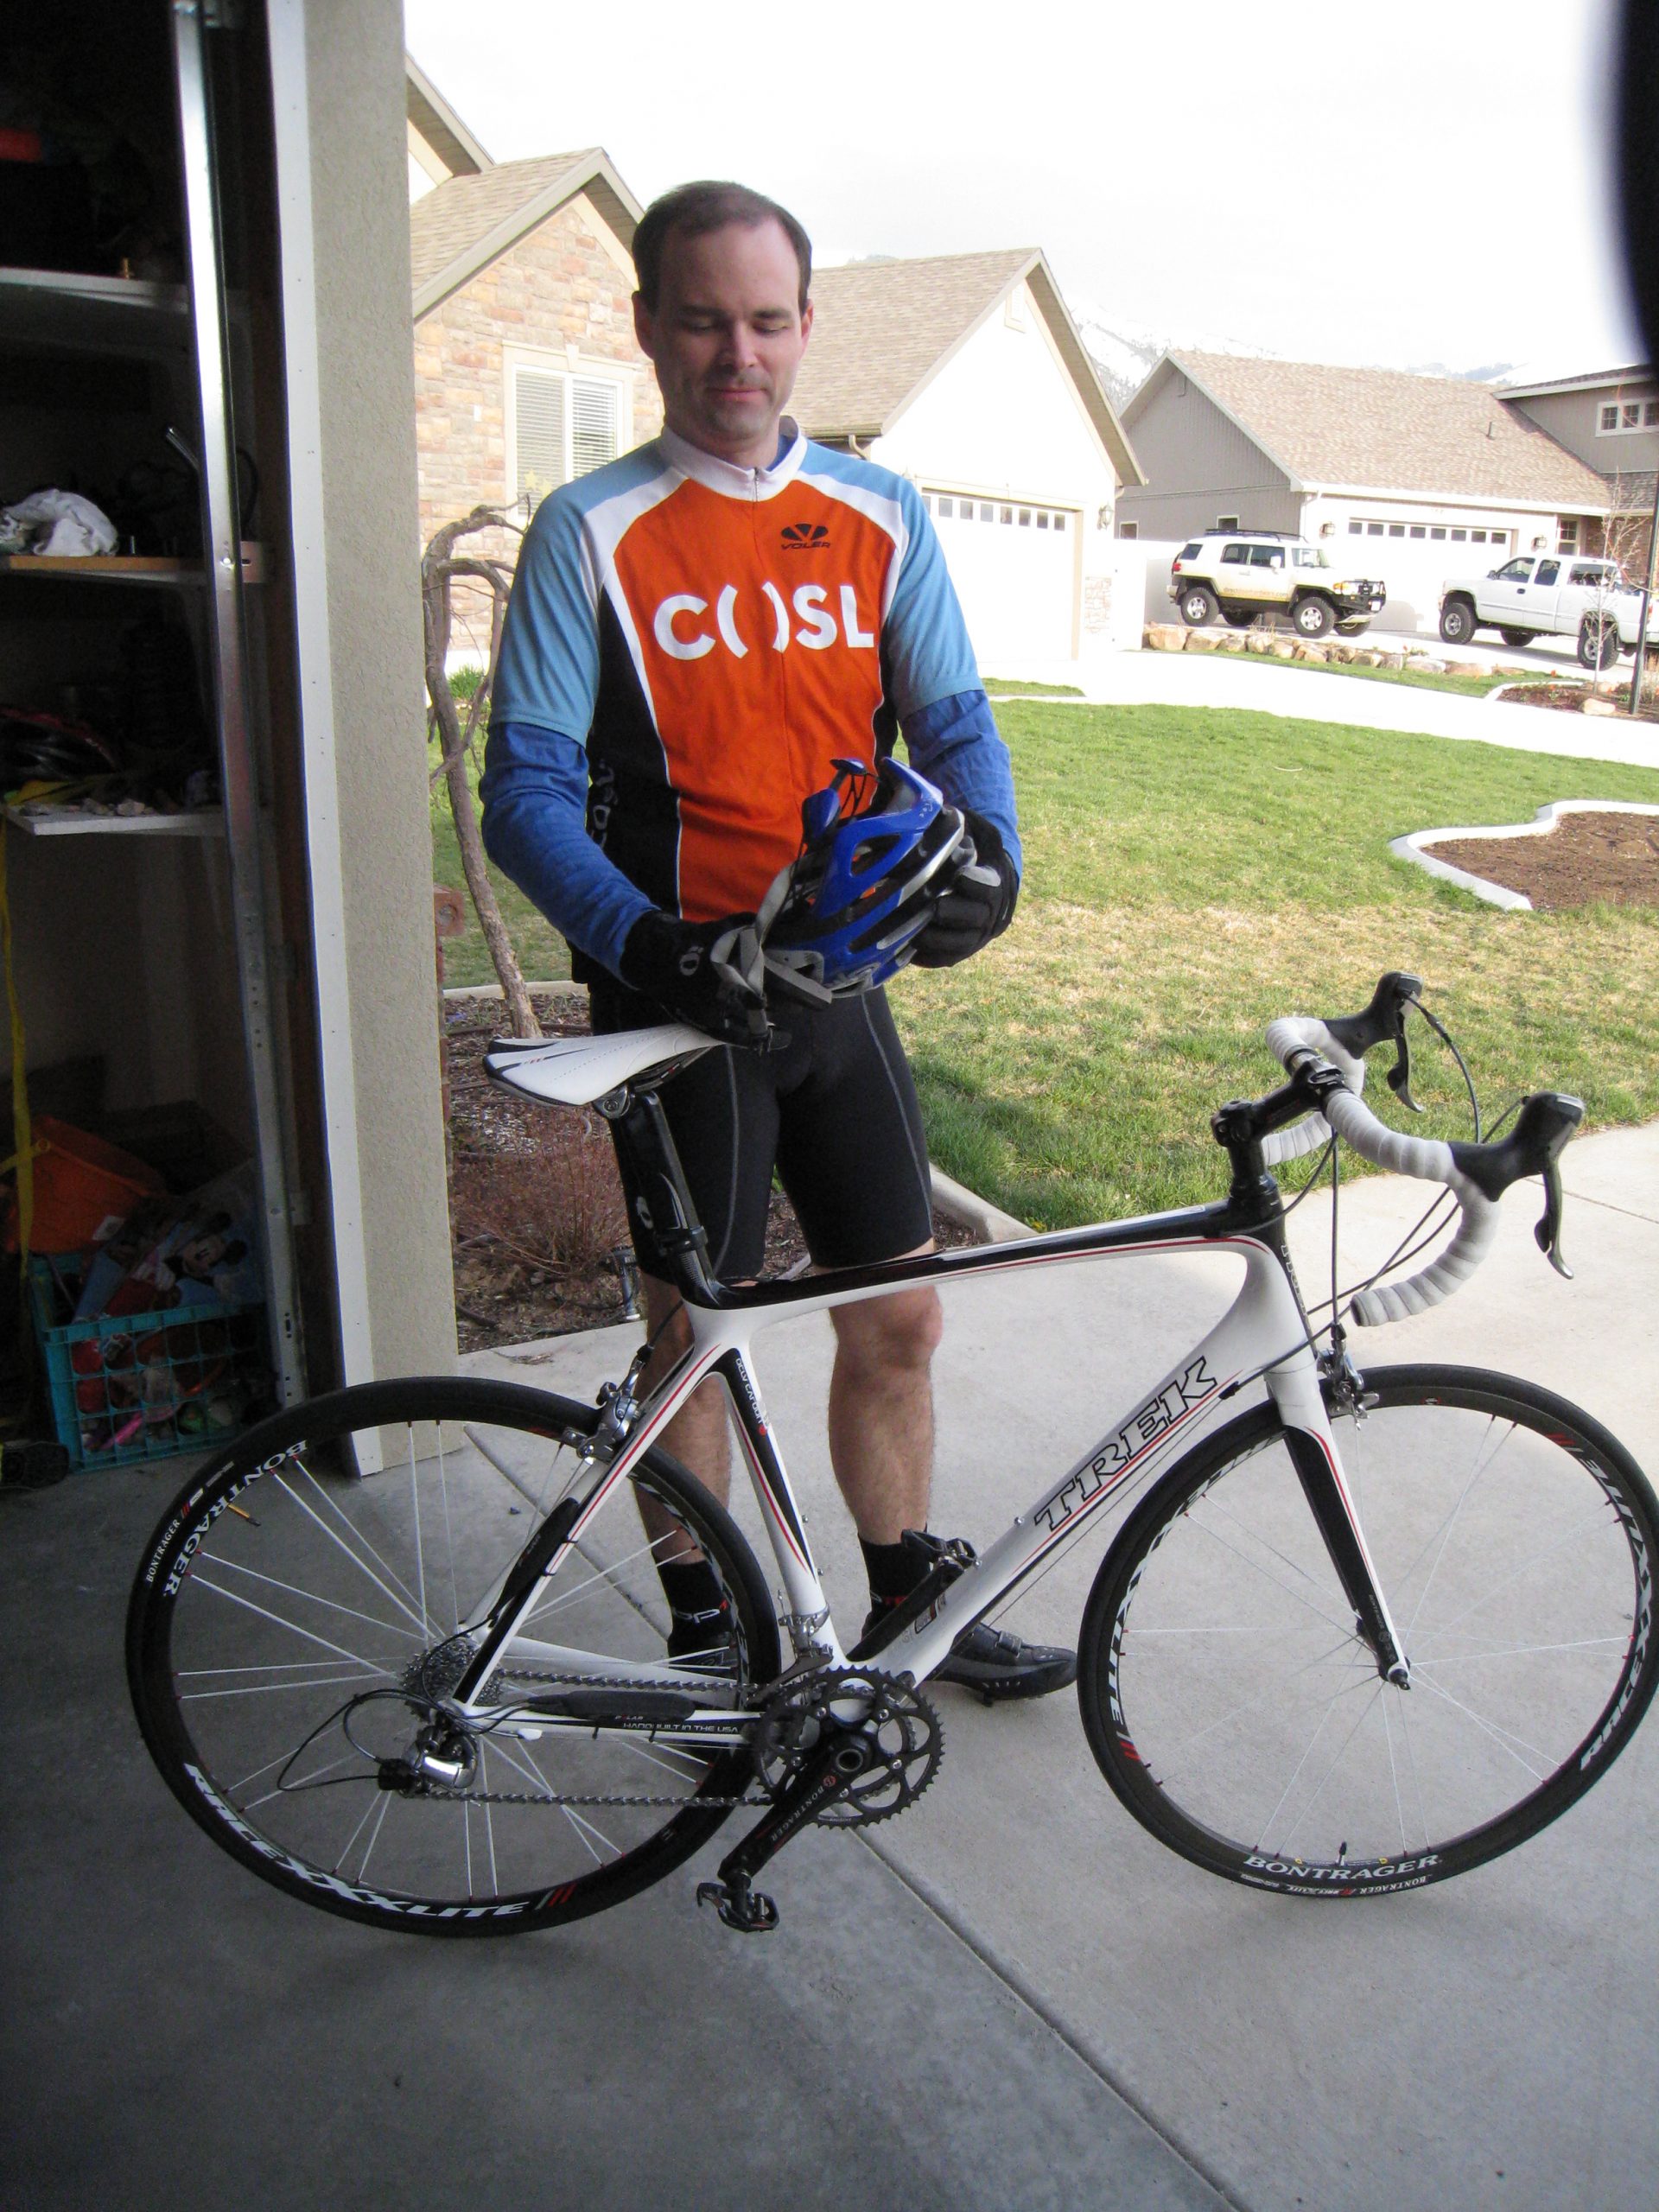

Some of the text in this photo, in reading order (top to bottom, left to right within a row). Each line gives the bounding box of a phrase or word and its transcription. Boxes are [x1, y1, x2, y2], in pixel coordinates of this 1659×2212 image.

[781, 541, 830, 550] VOLER
[1034, 1355, 1218, 1532] TREK
[163, 1440, 308, 1595] BONTRAGER
[145, 1519, 181, 1583] BONTRAGER
[1243, 1853, 1440, 1879] BONTRAGER
[1360, 1876, 1427, 1895] BONTRAGER
